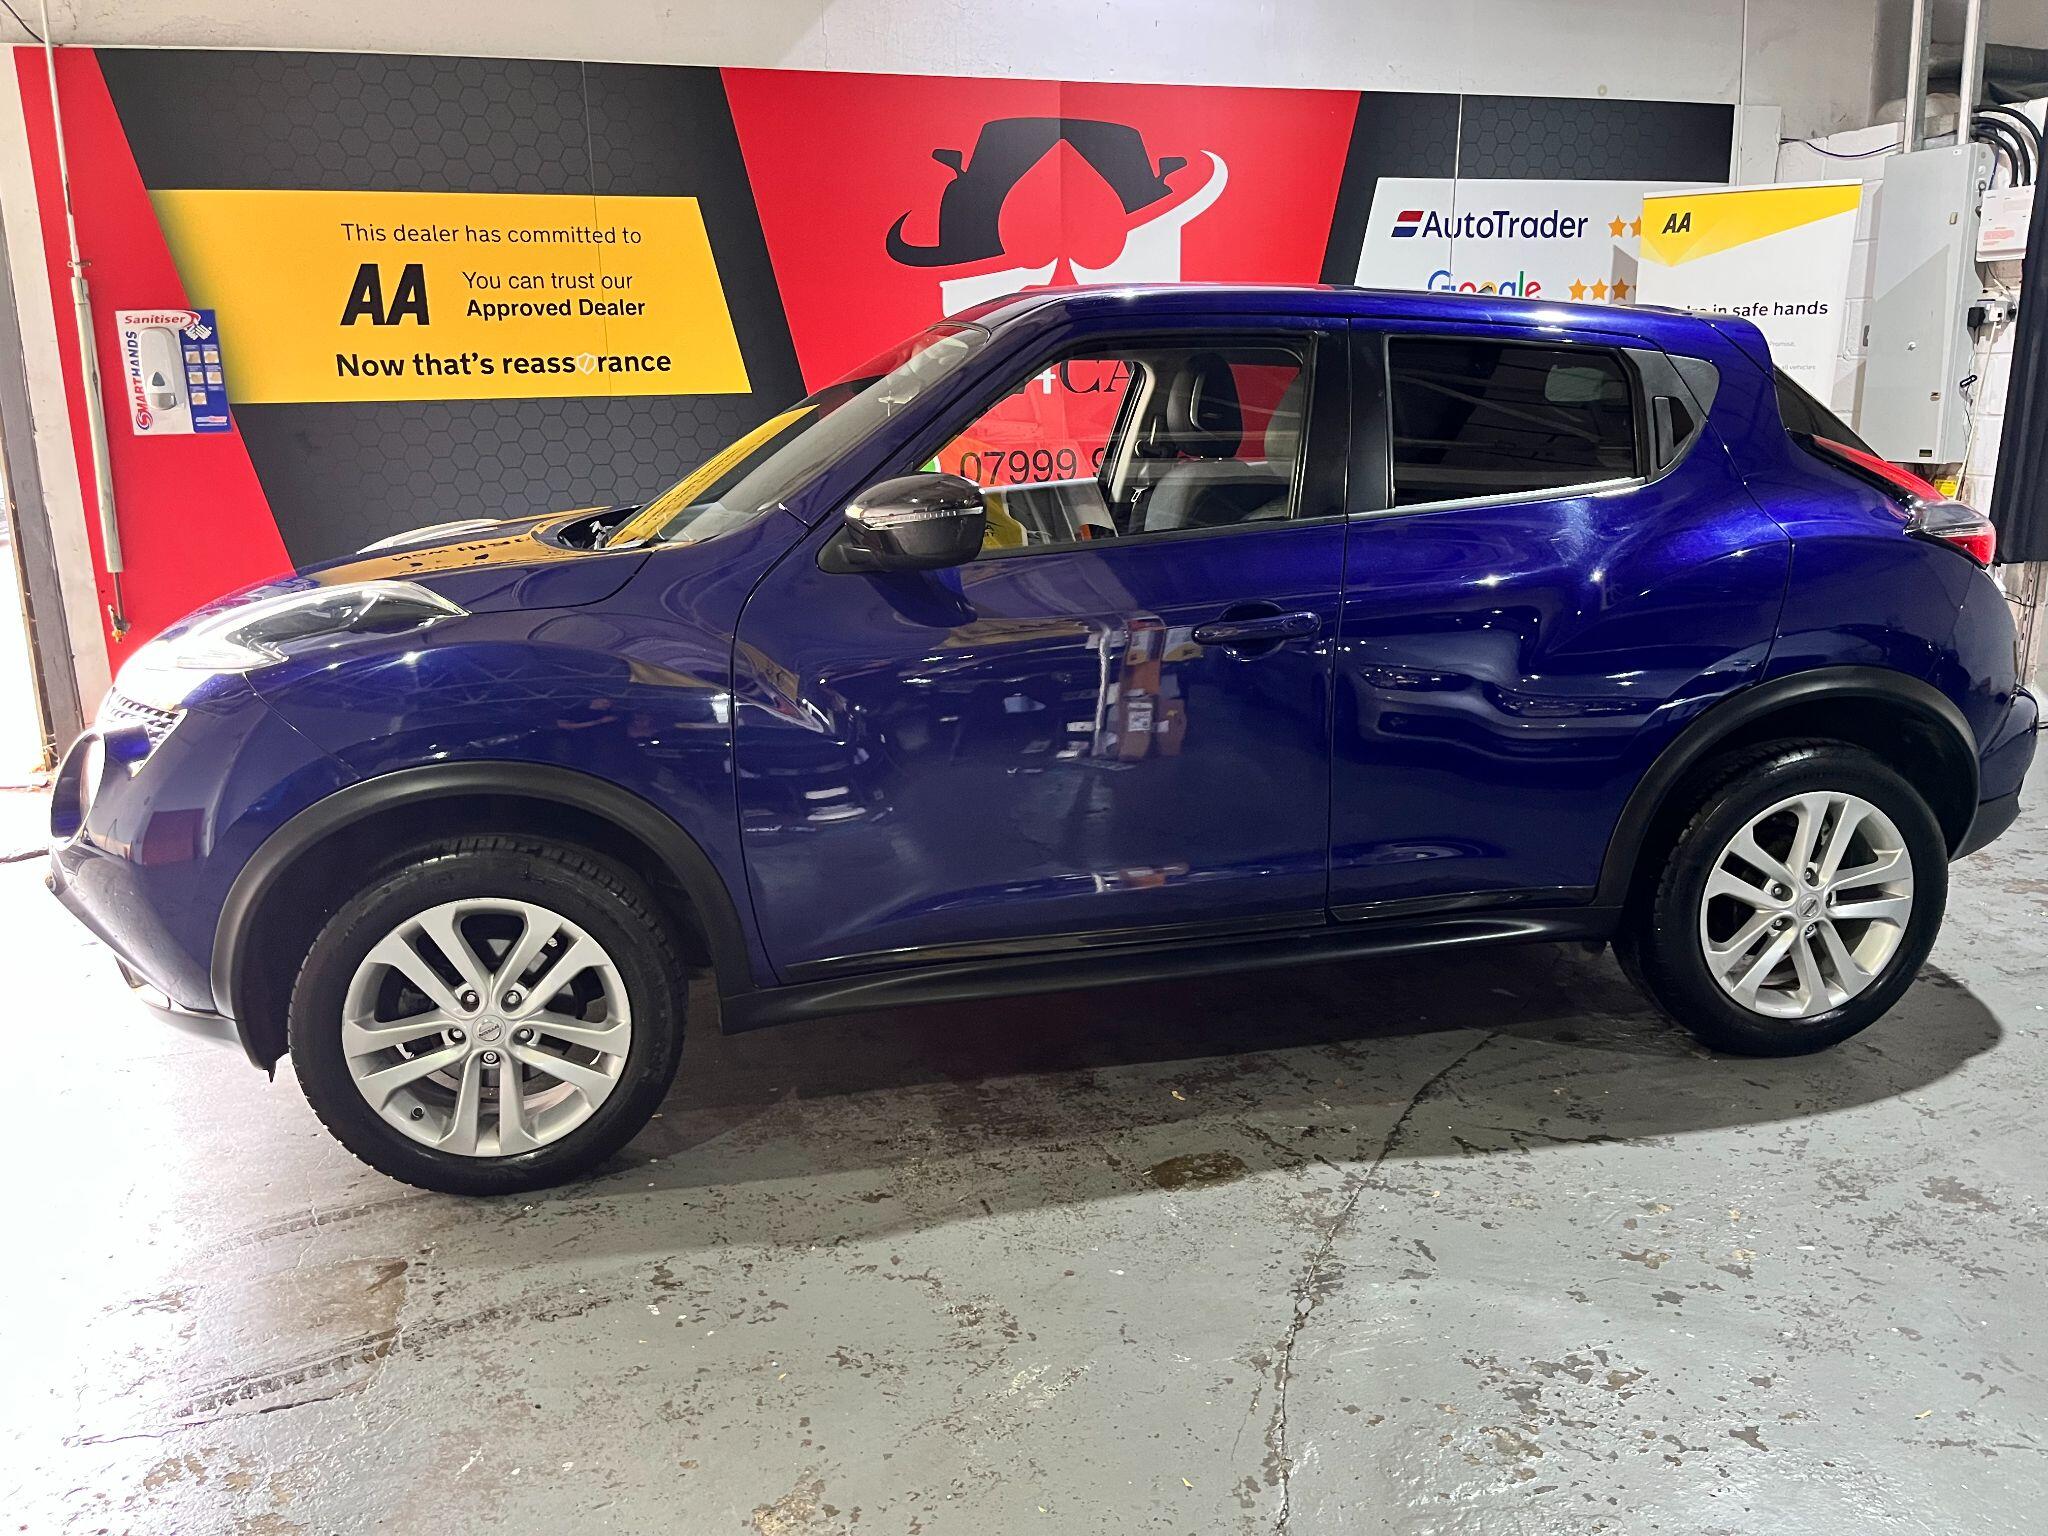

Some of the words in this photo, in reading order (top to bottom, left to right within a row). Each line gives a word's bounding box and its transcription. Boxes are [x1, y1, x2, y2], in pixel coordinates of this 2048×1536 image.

[340, 223, 387, 242] This
[393, 223, 460, 242] dealer
[465, 224, 502, 243] has
[507, 226, 616, 244] committed
[621, 227, 642, 244] to
[1421, 209, 1589, 239] AutoTrader
[1661, 212, 1692, 234] AA
[461, 271, 501, 289] You
[508, 275, 545, 289] can
[550, 272, 595, 289] trust
[601, 275, 633, 289] our
[339, 263, 430, 326] AA
[124, 315, 186, 324] Sanitiser
[466, 298, 572, 322] Approved
[578, 298, 646, 316] Dealer
[1732, 302, 1769, 317] safe
[1773, 301, 1829, 316] hands
[336, 353, 405, 377] Now
[412, 352, 495, 376] that's
[960, 449, 1077, 485] 07999
